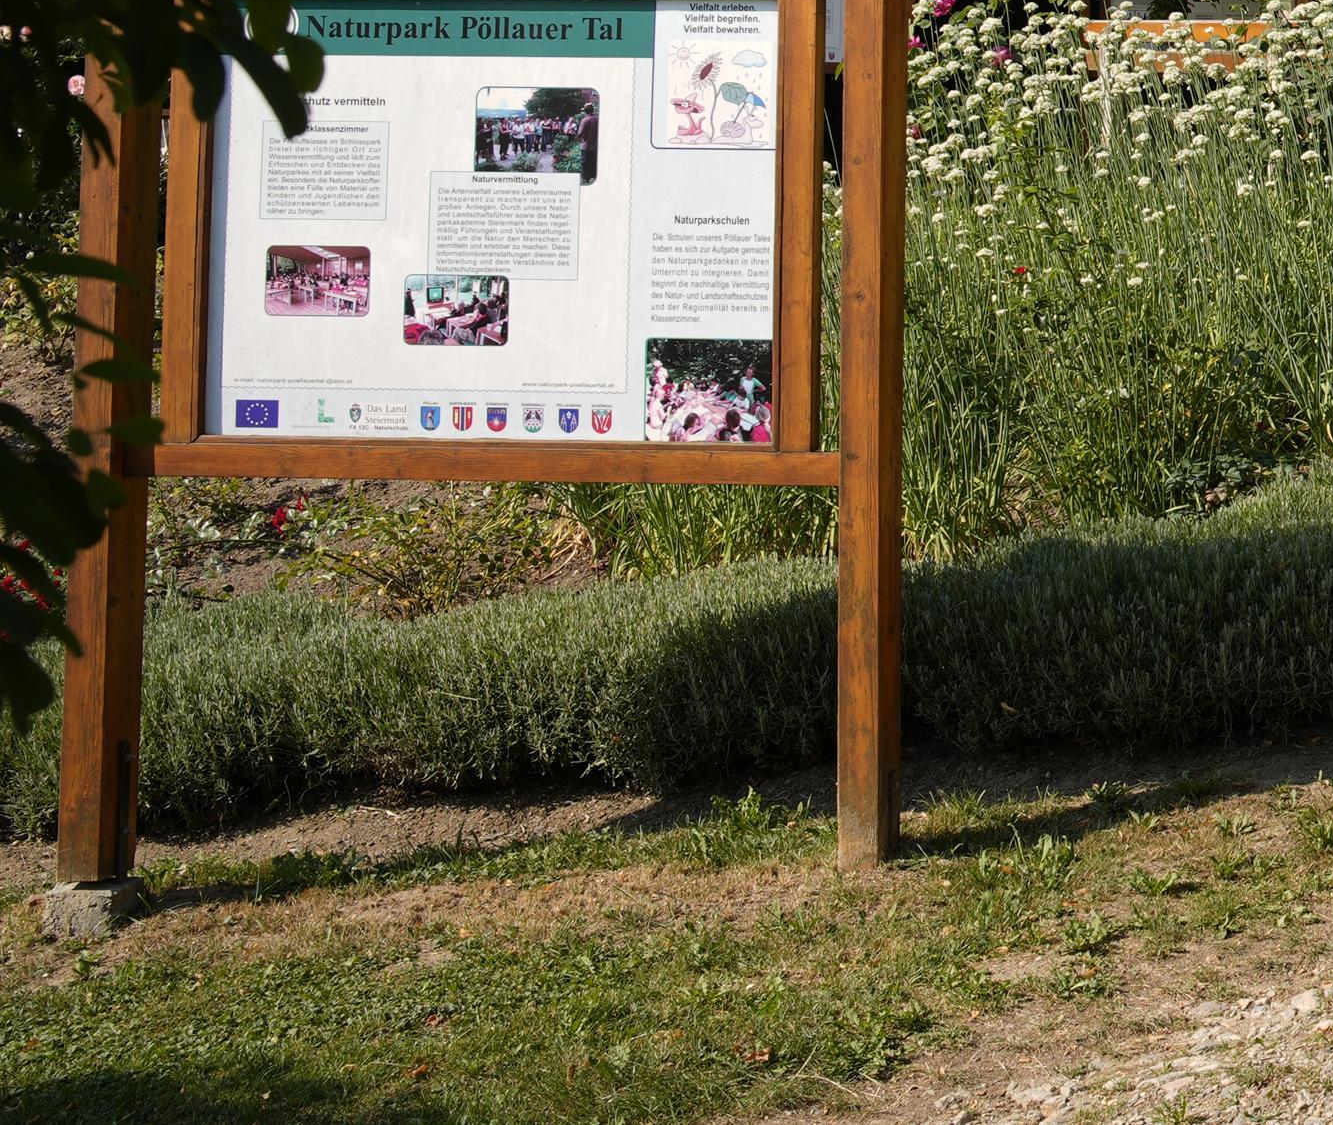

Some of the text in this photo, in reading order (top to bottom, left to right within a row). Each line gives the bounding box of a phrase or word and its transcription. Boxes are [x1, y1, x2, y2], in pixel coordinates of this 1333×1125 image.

[689, 3, 757, 12] Vielfalt erleben.
[685, 14, 760, 24] Vielfalt begreifen.
[307, 15, 623, 45] Naturpark Pöllauer Tal
[684, 25, 761, 34] Vielfalt bewahren.
[334, 97, 386, 106] vermitteln
[472, 176, 539, 185] Naturvermittlung
[438, 196, 483, 204] transparent
[465, 204, 497, 212] Anliegen.
[674, 215, 750, 226] Naturparkschulen
[515, 228, 571, 236] Veranstaltungen
[437, 251, 532, 259] Informationsveranstaltungen
[712, 246, 740, 255] Aufgabe
[741, 247, 770, 255] gemacht
[668, 257, 739, 267] Naturparkgedanken
[436, 266, 511, 274] Naturschutzgedankens.
[702, 269, 744, 278] integrieren.
[652, 280, 676, 289] beginnt
[691, 281, 729, 290] nachhaltige
[732, 281, 770, 290] Vermittlung
[683, 304, 729, 313] Regionalität
[651, 315, 702, 323] Klassenzimmer.
[386, 405, 407, 413] Land
[365, 416, 406, 424] Steiermark
